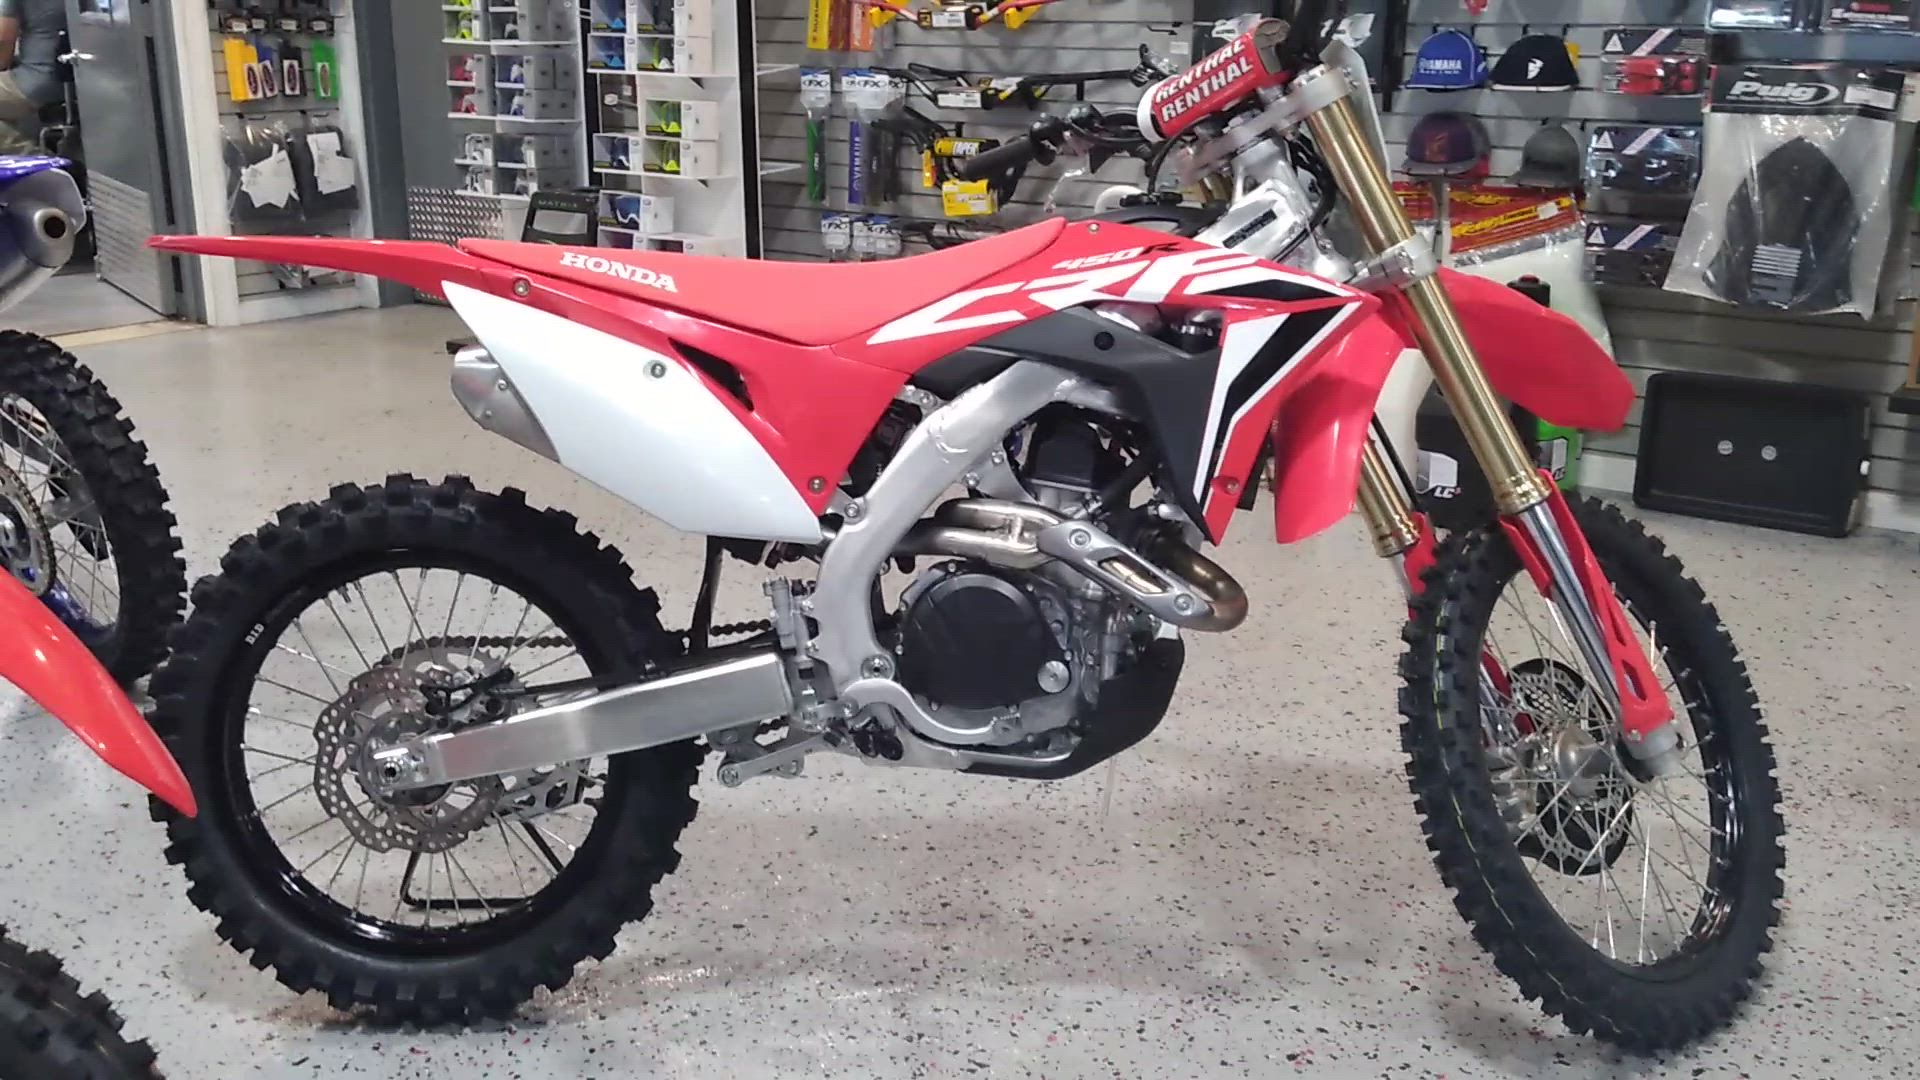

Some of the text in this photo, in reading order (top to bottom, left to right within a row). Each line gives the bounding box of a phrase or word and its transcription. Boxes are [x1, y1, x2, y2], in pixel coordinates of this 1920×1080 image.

[1155, 39, 1246, 103] RENTHAL
[1161, 56, 1254, 122] RENTHAL
[1729, 81, 1819, 101] Puig
[560, 252, 678, 293] HONDA
